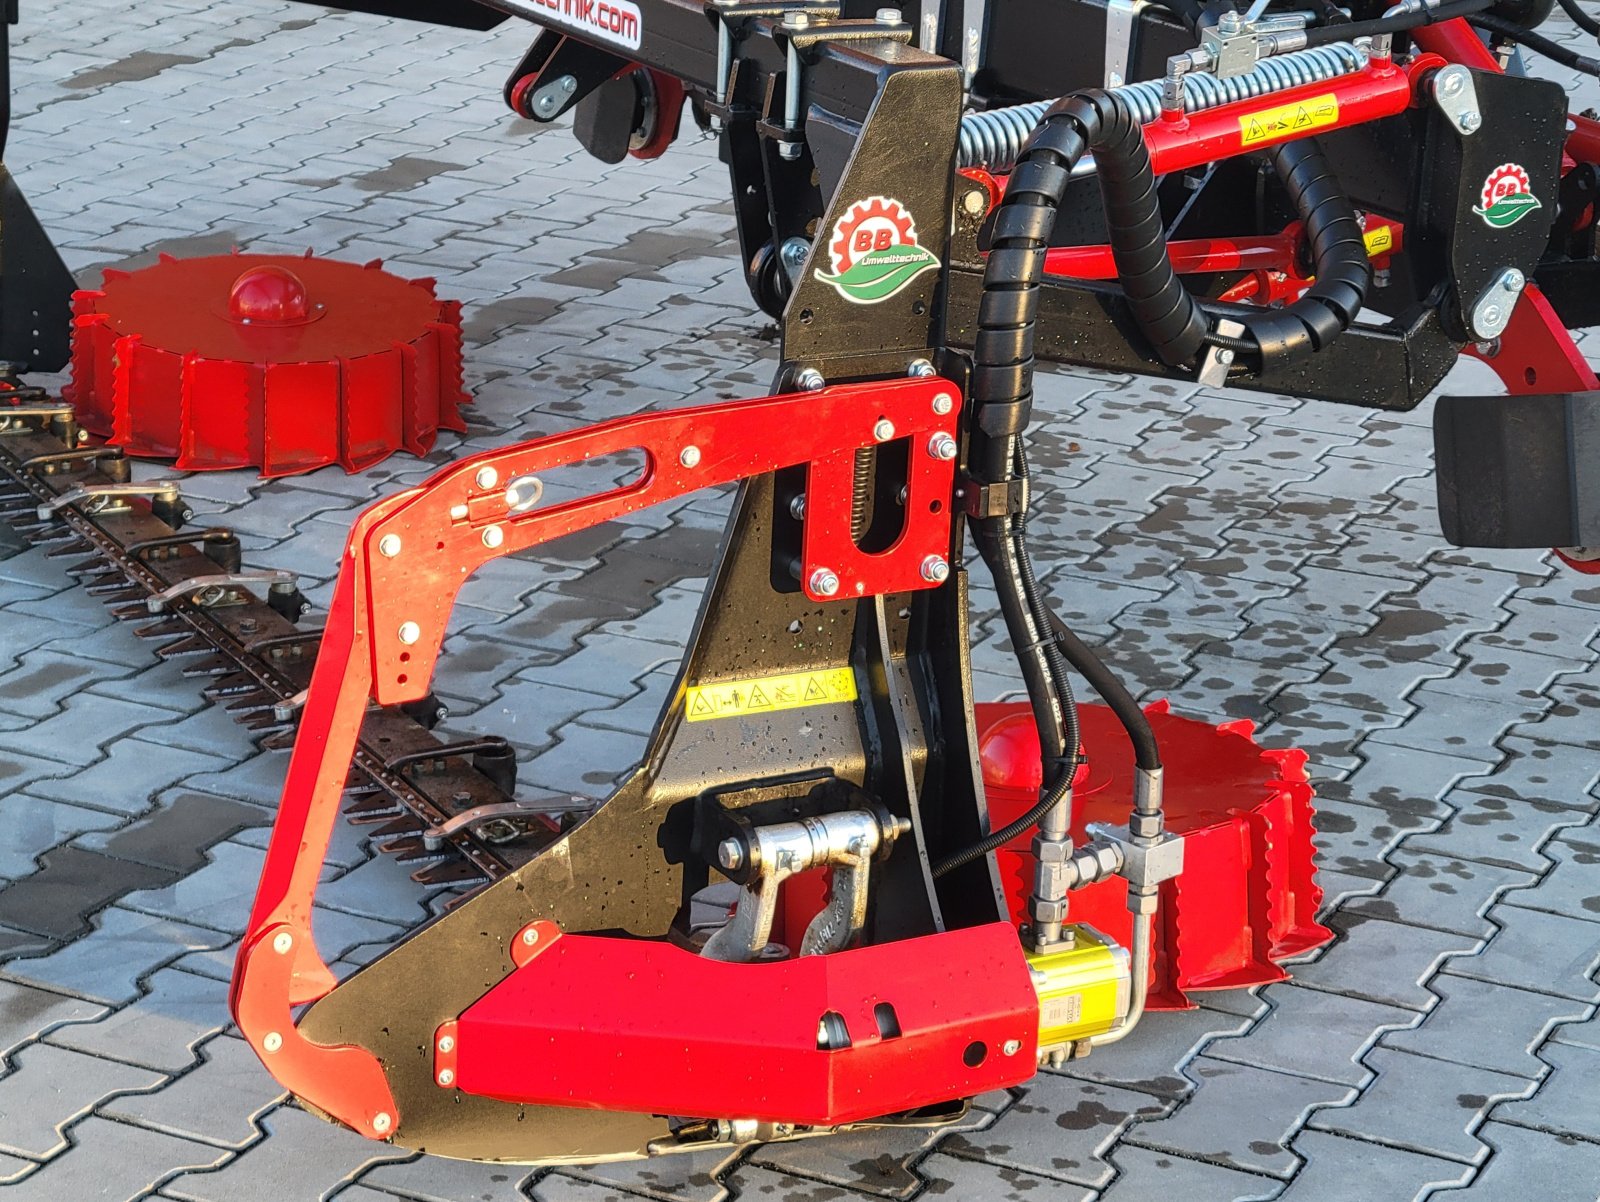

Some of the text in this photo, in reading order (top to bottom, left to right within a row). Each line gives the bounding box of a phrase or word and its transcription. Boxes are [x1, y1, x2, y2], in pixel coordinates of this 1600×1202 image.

[1495, 183, 1517, 196] BB
[854, 228, 893, 252] BB
[861, 252, 930, 266] Umwelttechnik
[1015, 578, 1026, 600] BAR
[1025, 613, 1039, 643] MSHA
